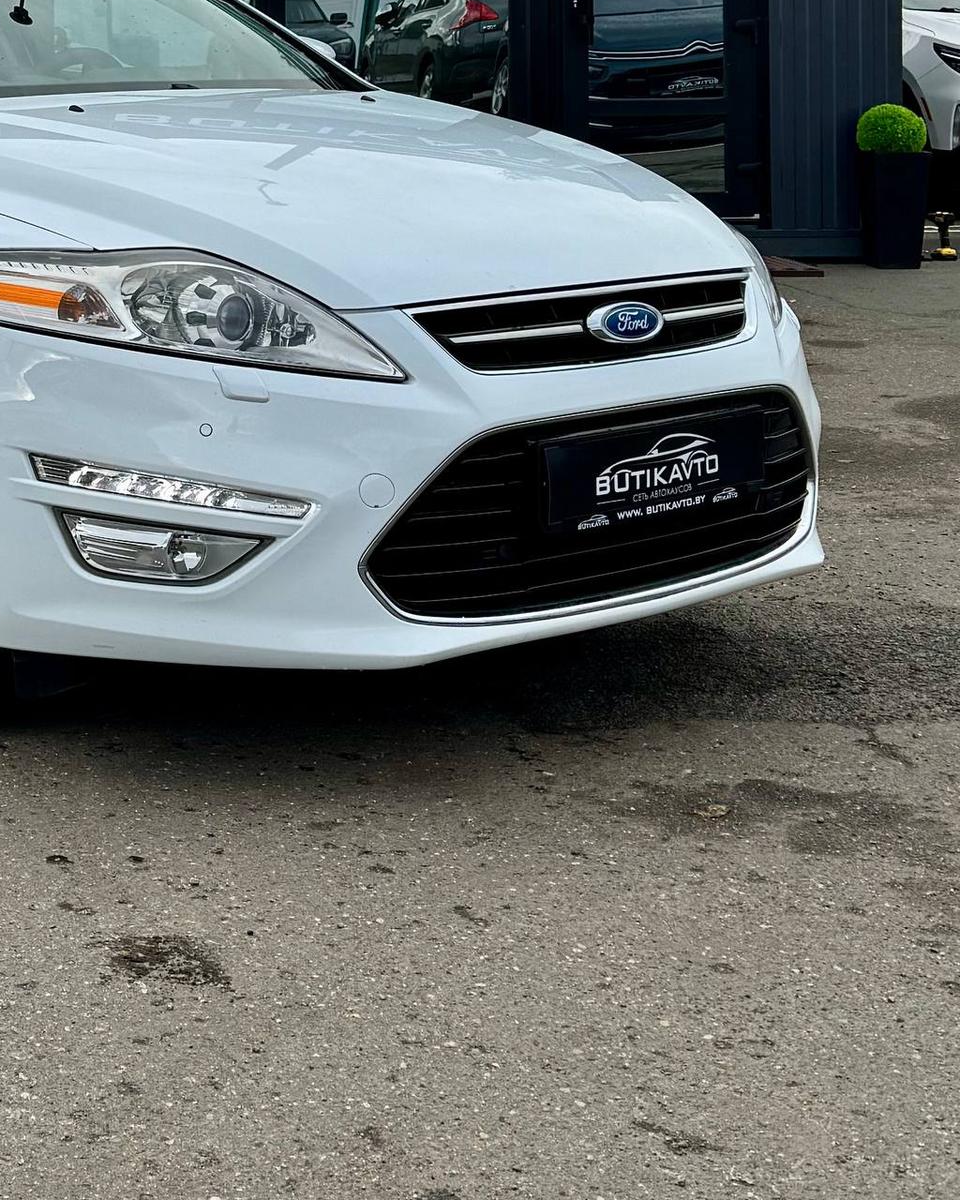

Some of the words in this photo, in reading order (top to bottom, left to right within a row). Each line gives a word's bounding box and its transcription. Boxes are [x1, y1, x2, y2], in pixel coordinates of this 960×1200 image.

[617, 310, 650, 332] Ford
[595, 454, 719, 496] BUTIKAVTO
[650, 483, 693, 500] АВТОХАУСОВ
[646, 495, 706, 515] BUTIKAVTO.BY
